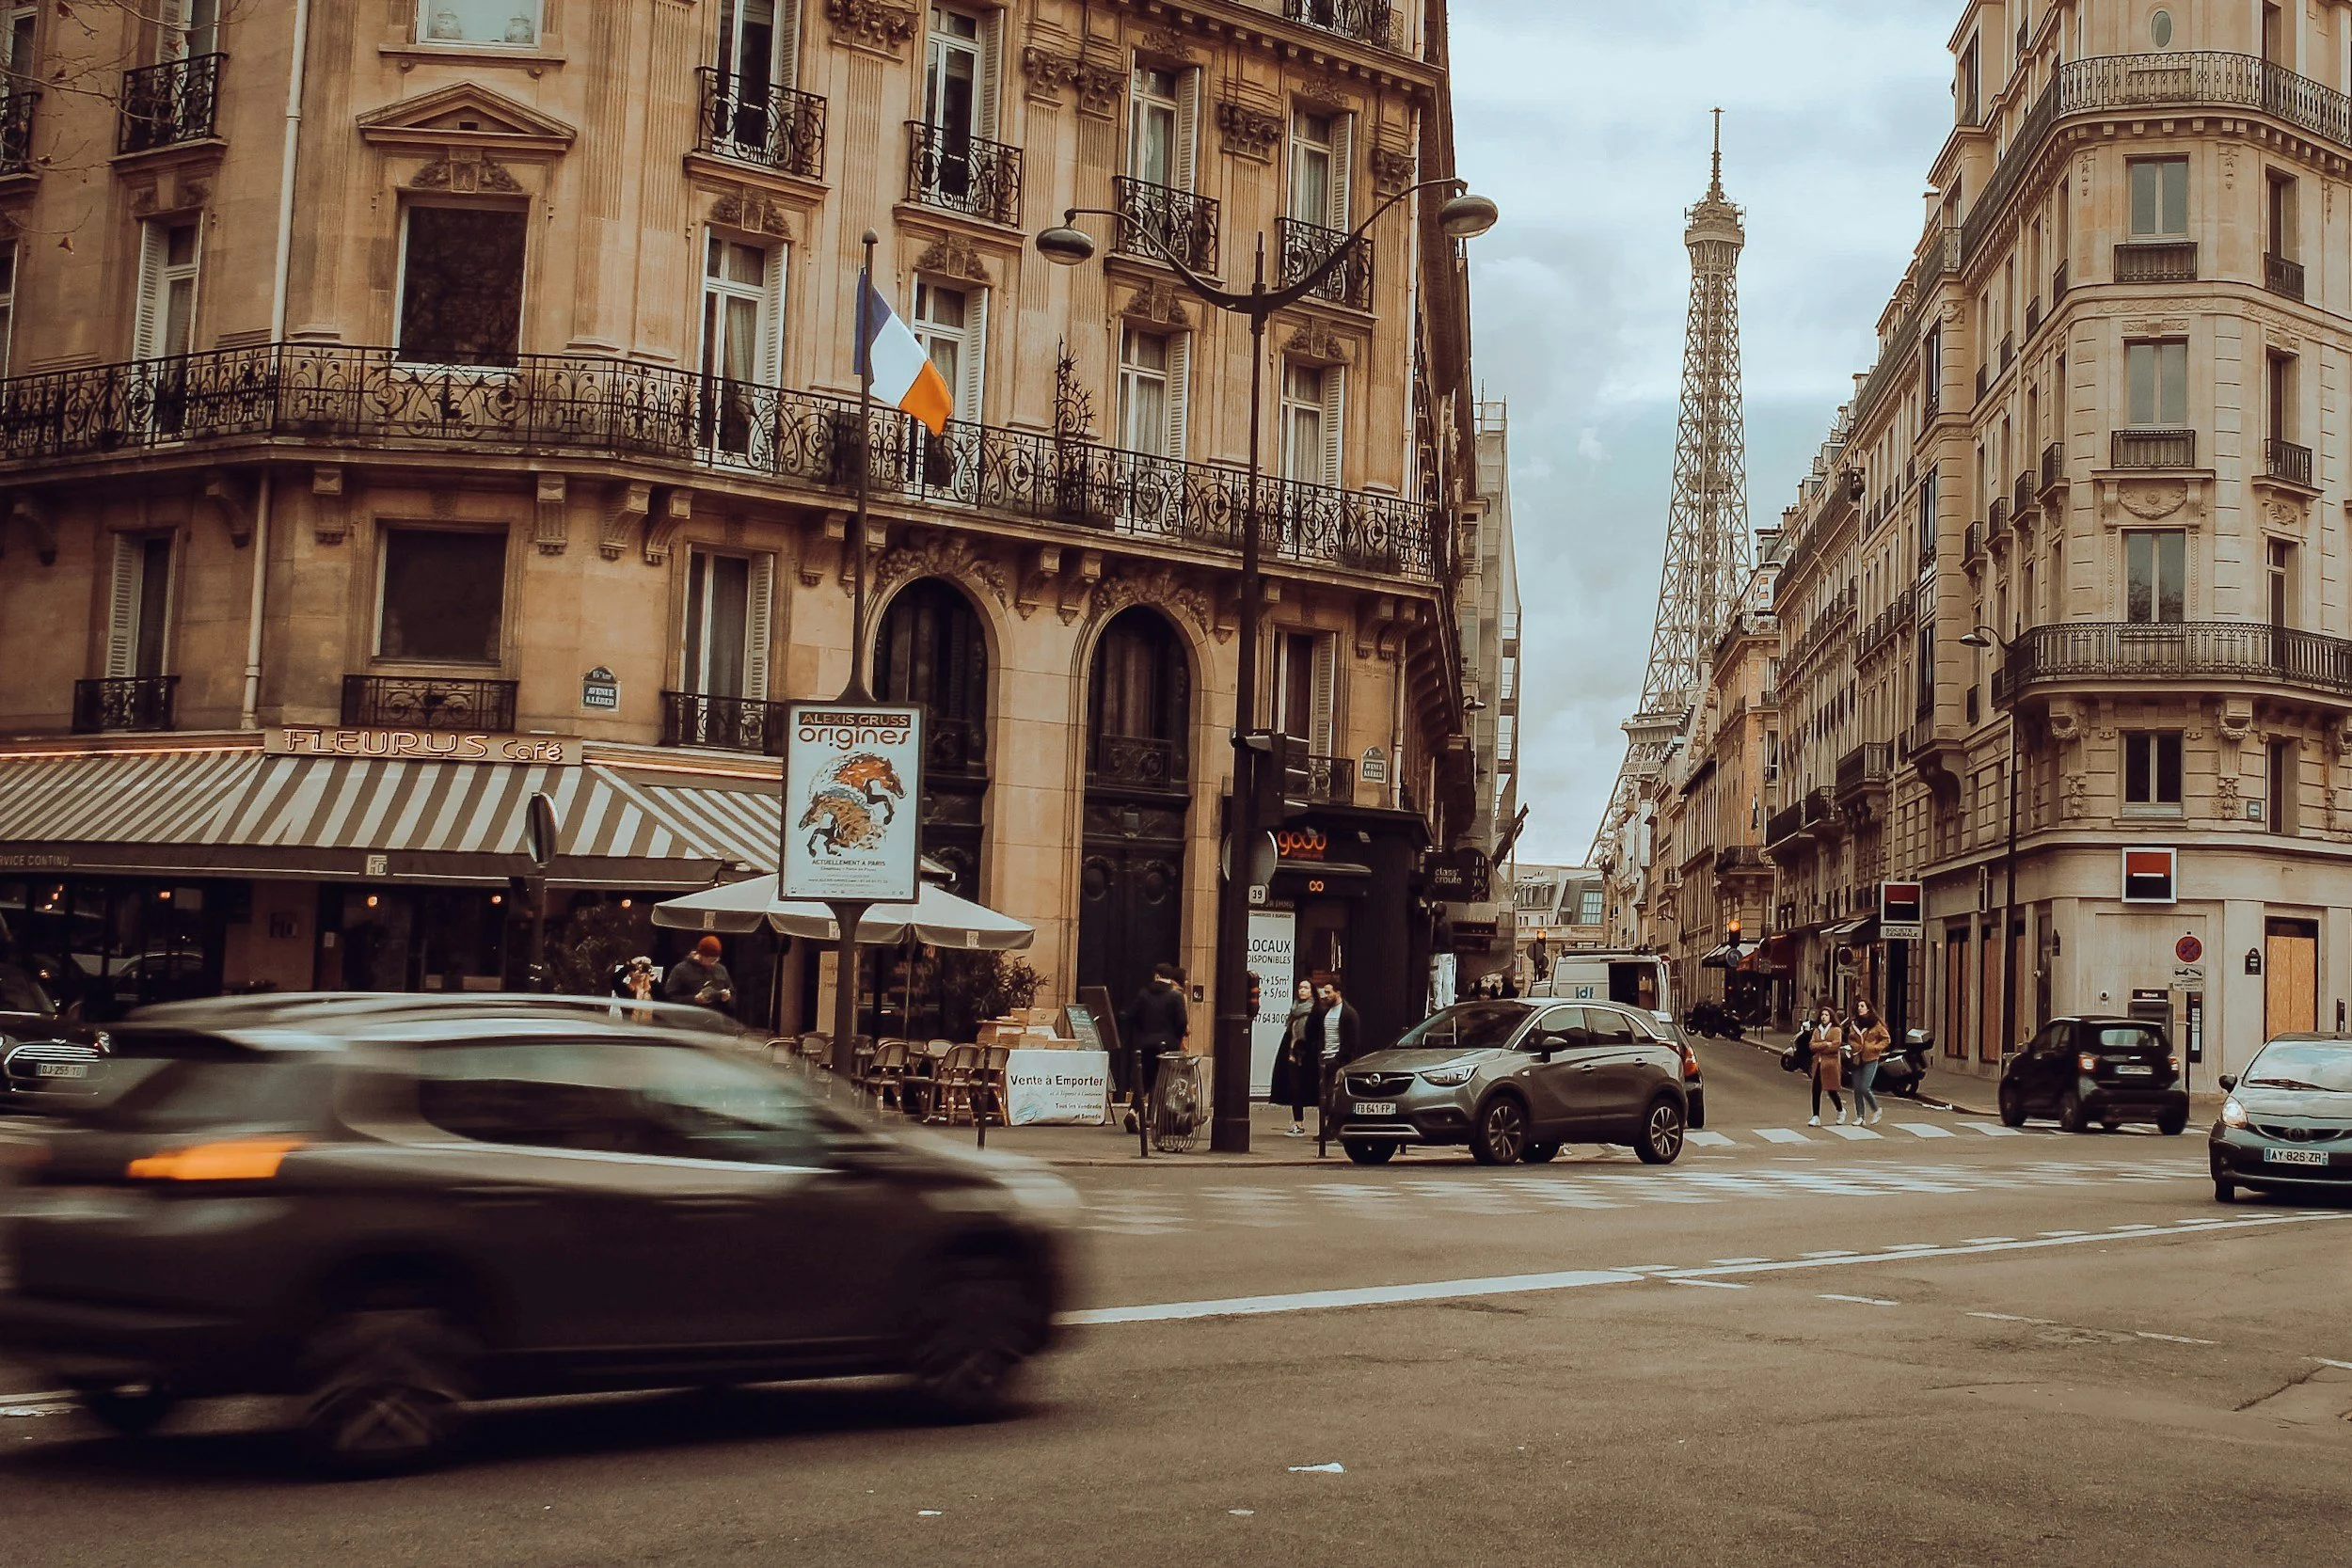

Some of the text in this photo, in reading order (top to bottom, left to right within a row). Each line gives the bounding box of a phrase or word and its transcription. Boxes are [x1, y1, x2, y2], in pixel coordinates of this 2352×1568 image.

[802, 713, 908, 726] ALEXIS GRUSS
[282, 728, 564, 762] FLEURUS Café
[1252, 889, 1263, 899] 39
[1010, 1075, 1104, 1087] Vente à Emporter
